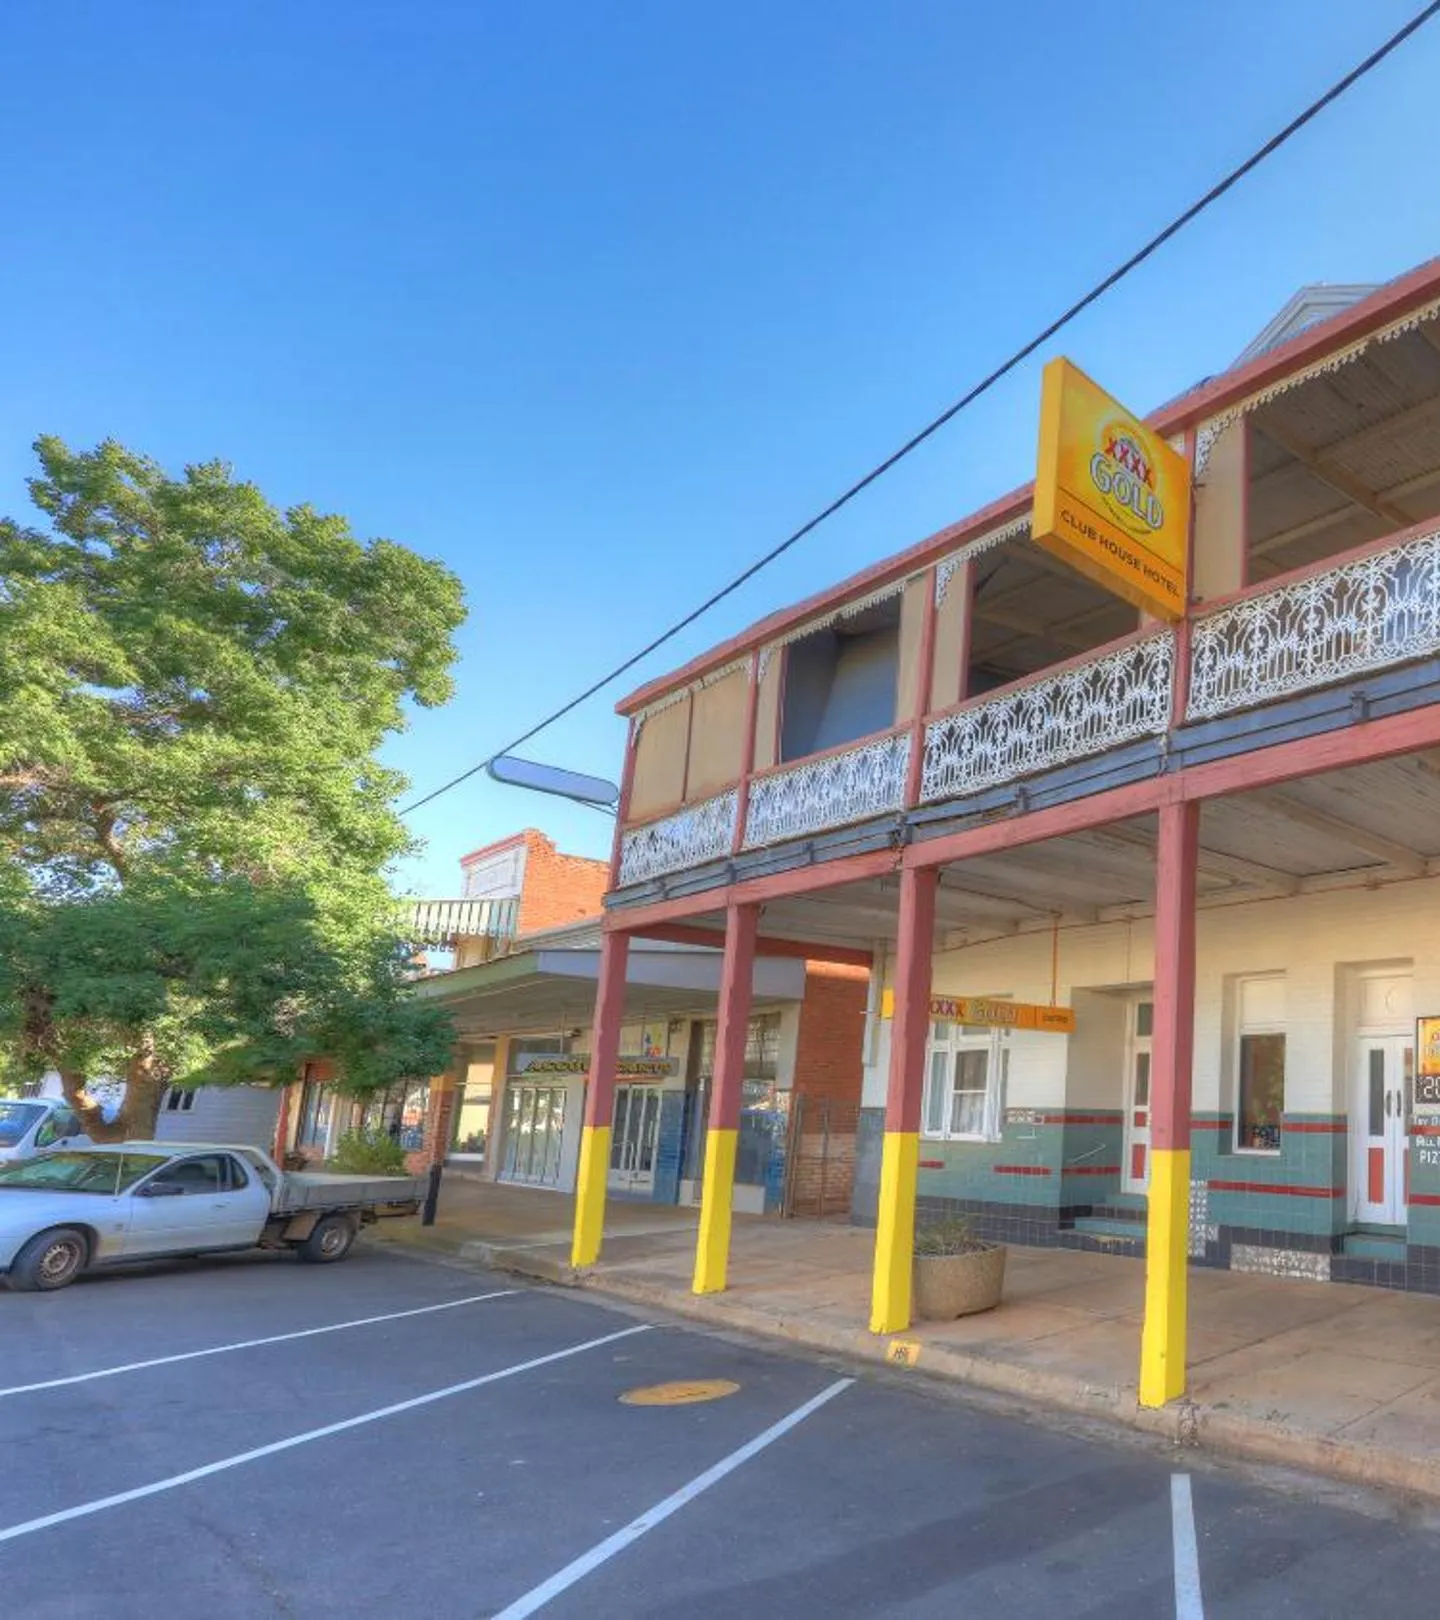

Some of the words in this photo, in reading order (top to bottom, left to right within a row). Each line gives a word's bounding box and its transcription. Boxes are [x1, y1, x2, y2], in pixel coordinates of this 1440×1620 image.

[1090, 452, 1164, 530] GOLD
[1105, 436, 1152, 489] XXXX
[1060, 509, 1098, 540] CLUB
[1099, 534, 1141, 570] HOUSE
[1142, 564, 1180, 598] HOTEL
